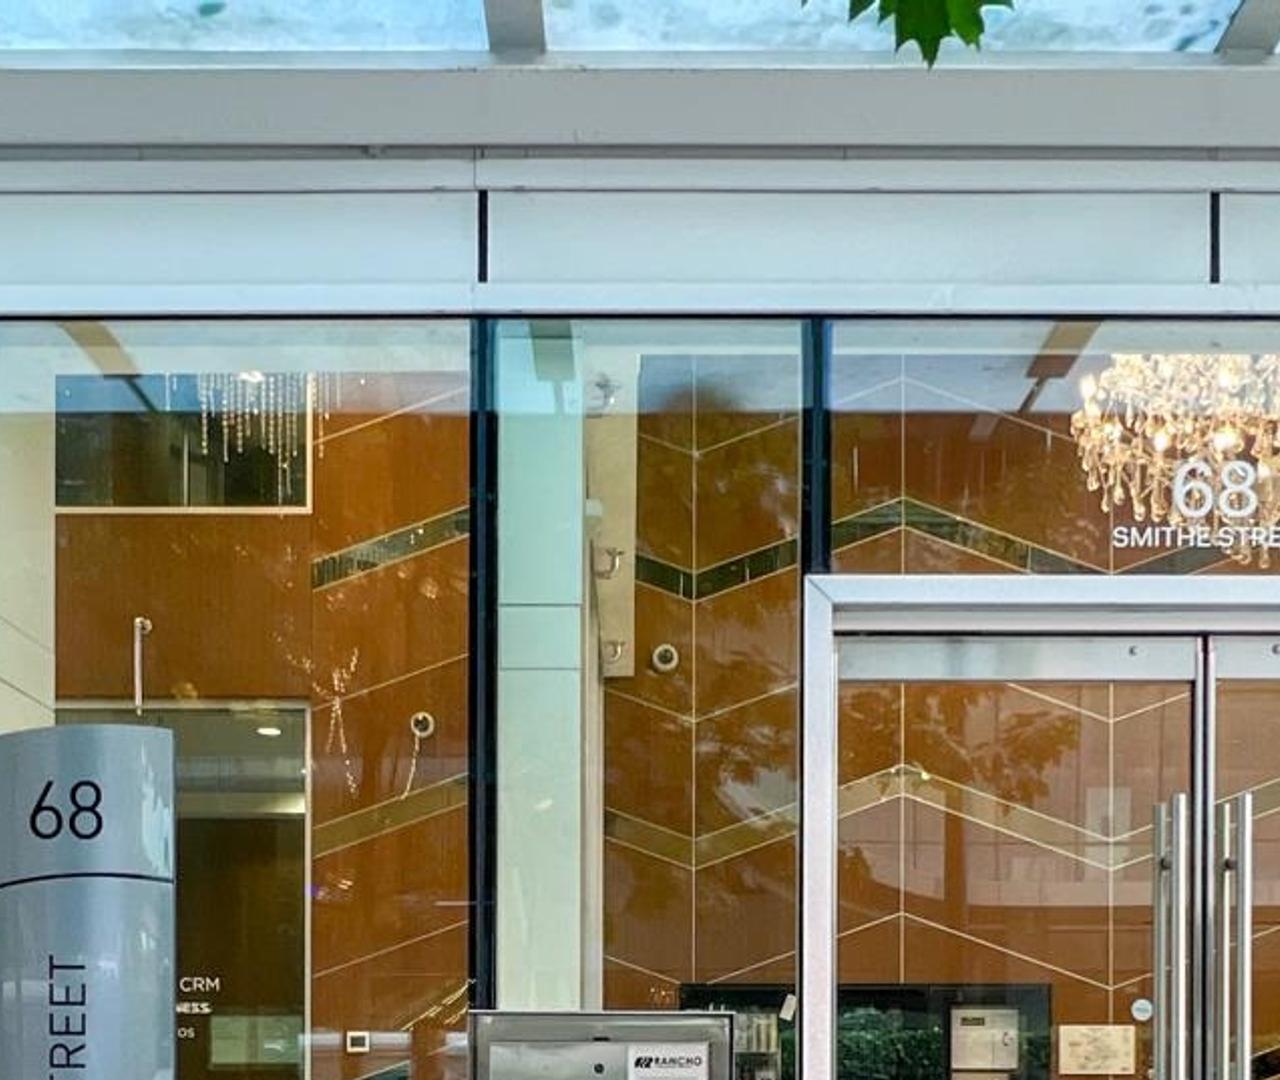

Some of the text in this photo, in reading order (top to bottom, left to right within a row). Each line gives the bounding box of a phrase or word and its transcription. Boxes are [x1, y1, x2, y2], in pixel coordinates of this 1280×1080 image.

[1172, 460, 1258, 519] 68
[1112, 526, 1212, 549] SMITHE
[29, 780, 104, 840] 68
[179, 976, 221, 993] CRM
[654, 1056, 703, 1067] RANCHO
